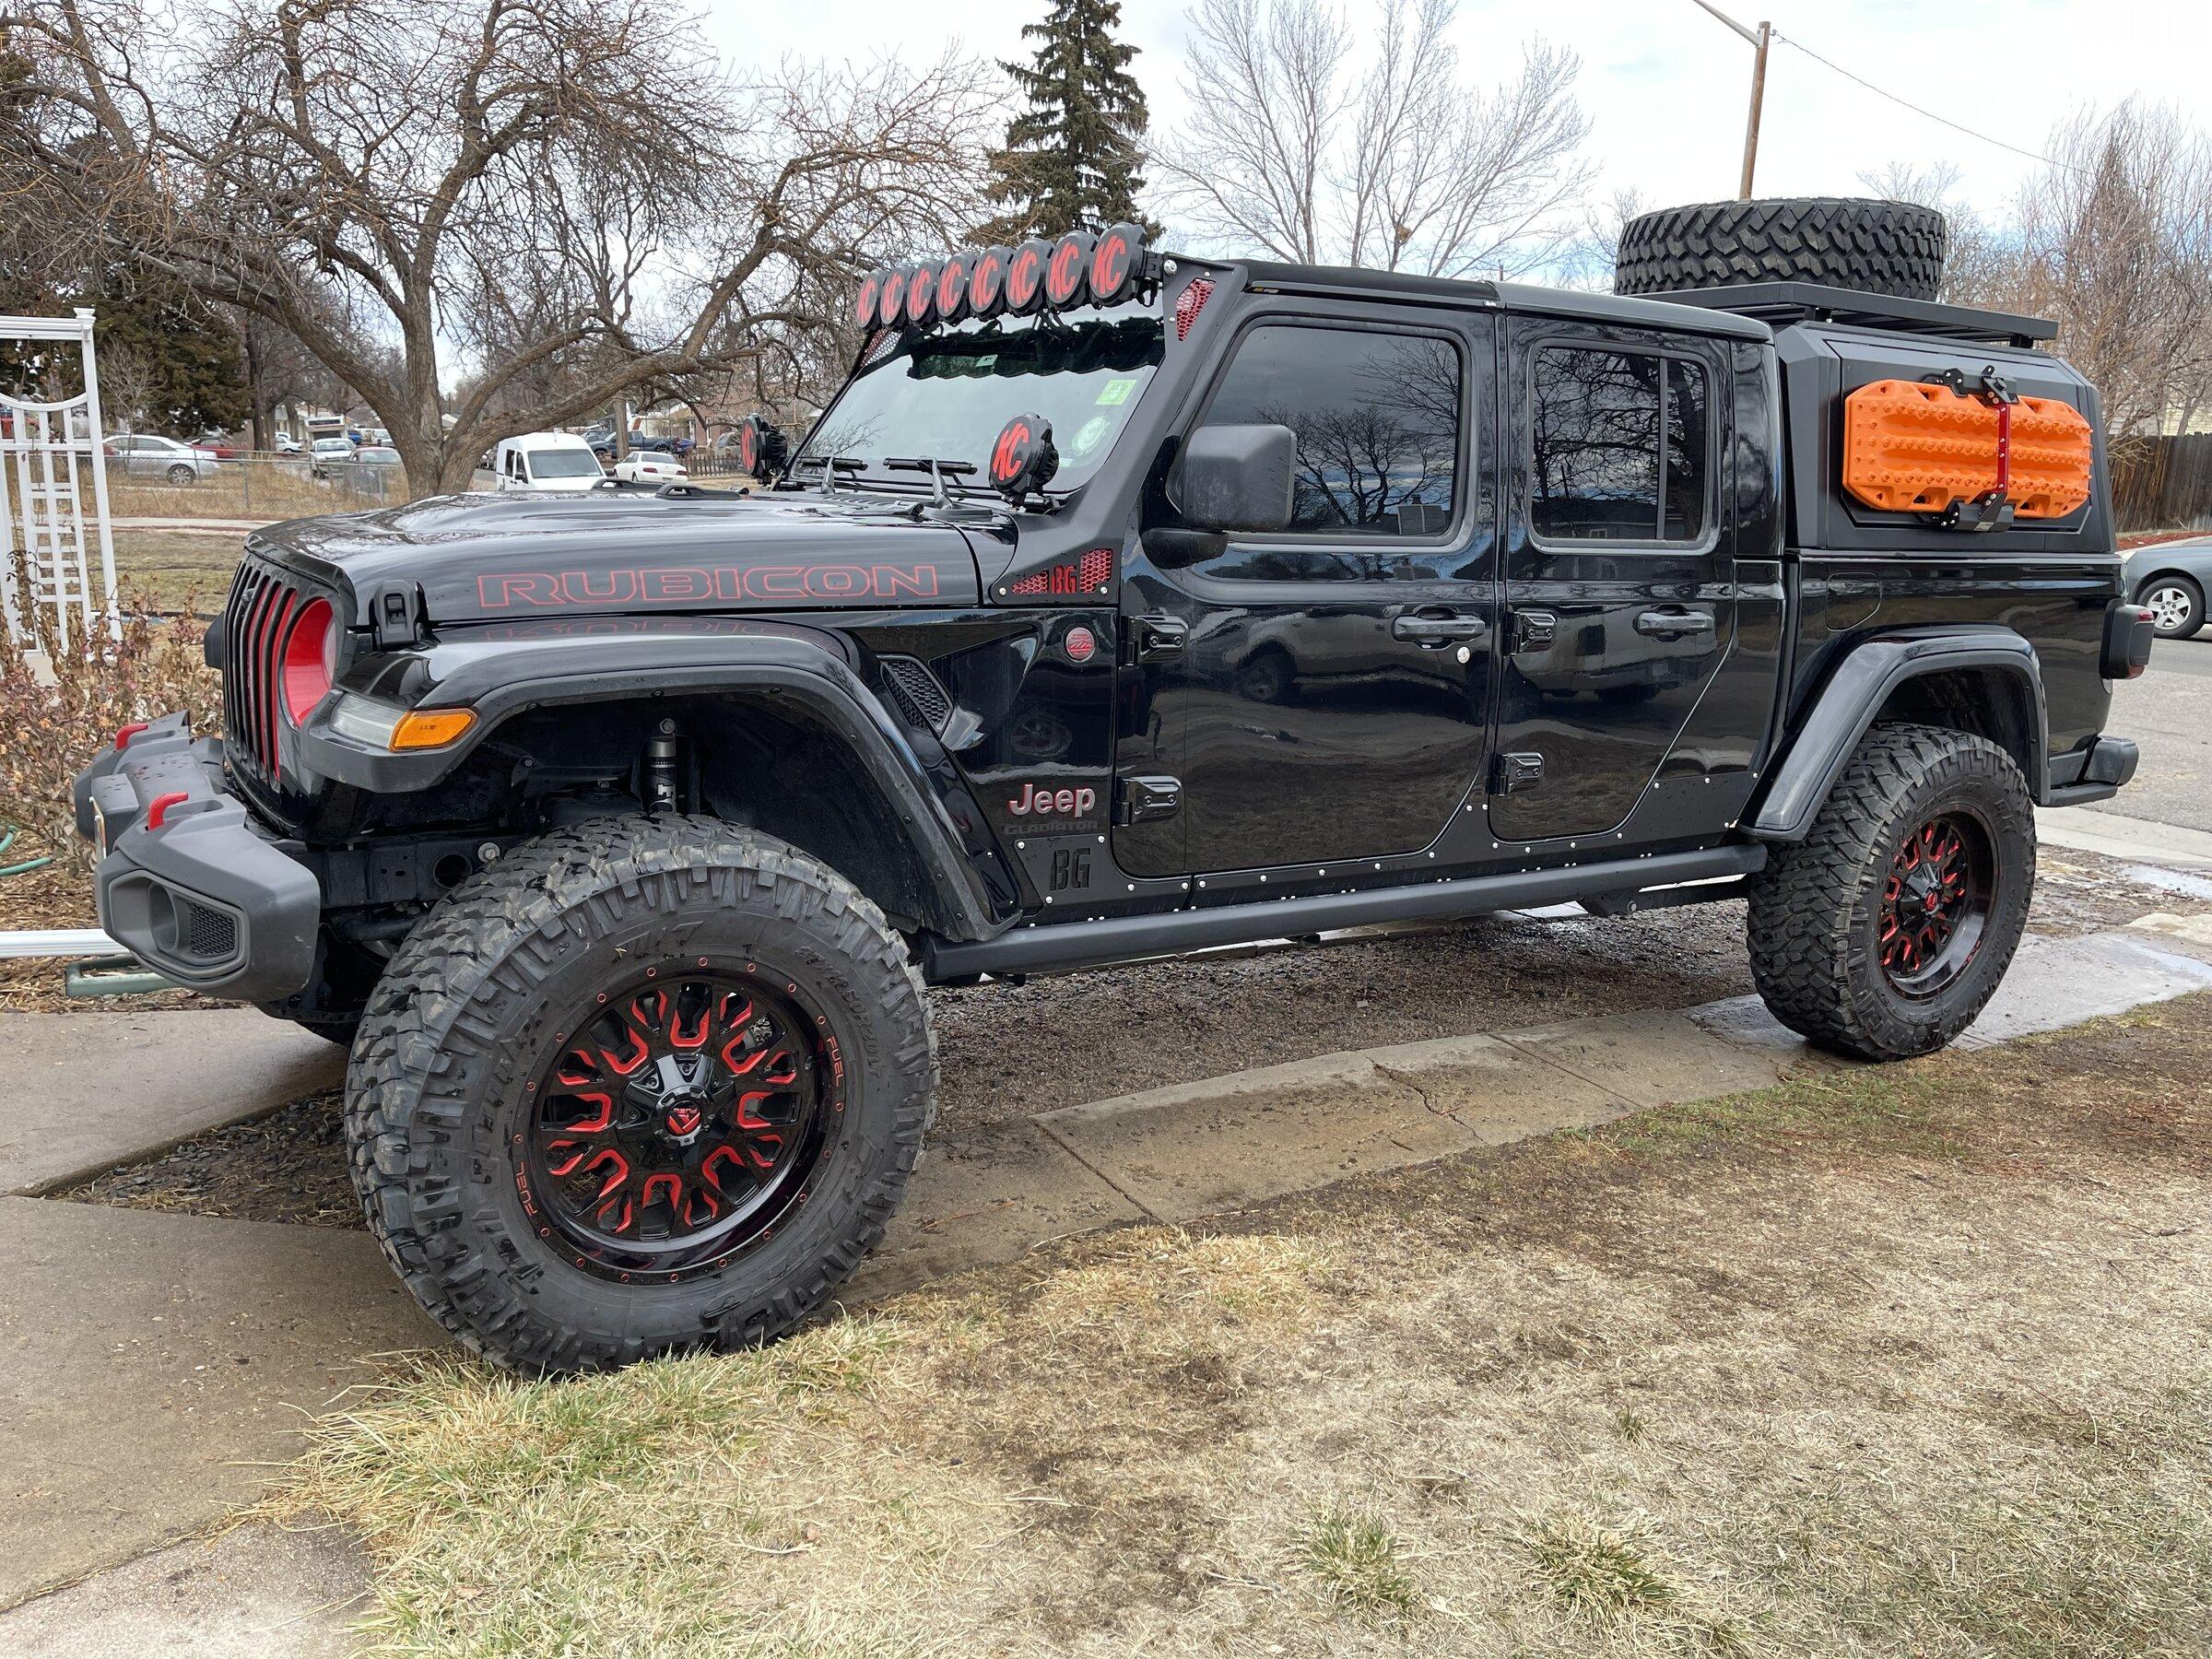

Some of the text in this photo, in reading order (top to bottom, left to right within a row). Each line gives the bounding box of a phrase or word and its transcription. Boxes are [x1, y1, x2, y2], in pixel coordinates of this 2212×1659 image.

[939, 261, 962, 312] KC
[972, 254, 998, 308] KC
[1009, 250, 1038, 306] KC
[1048, 241, 1079, 300] KC
[1091, 235, 1126, 295] KC
[882, 273, 902, 321] KC
[909, 268, 931, 318] KC
[992, 422, 1030, 481] KC
[477, 565, 938, 608] RUBICON
[1051, 564, 1077, 594] BG
[1008, 782, 1097, 818] Jeep
[1004, 820, 1099, 835] GLADIATOR
[1049, 847, 1091, 892] BG
[826, 1035, 844, 1088] FUEL
[515, 1160, 538, 1217] FUEL
